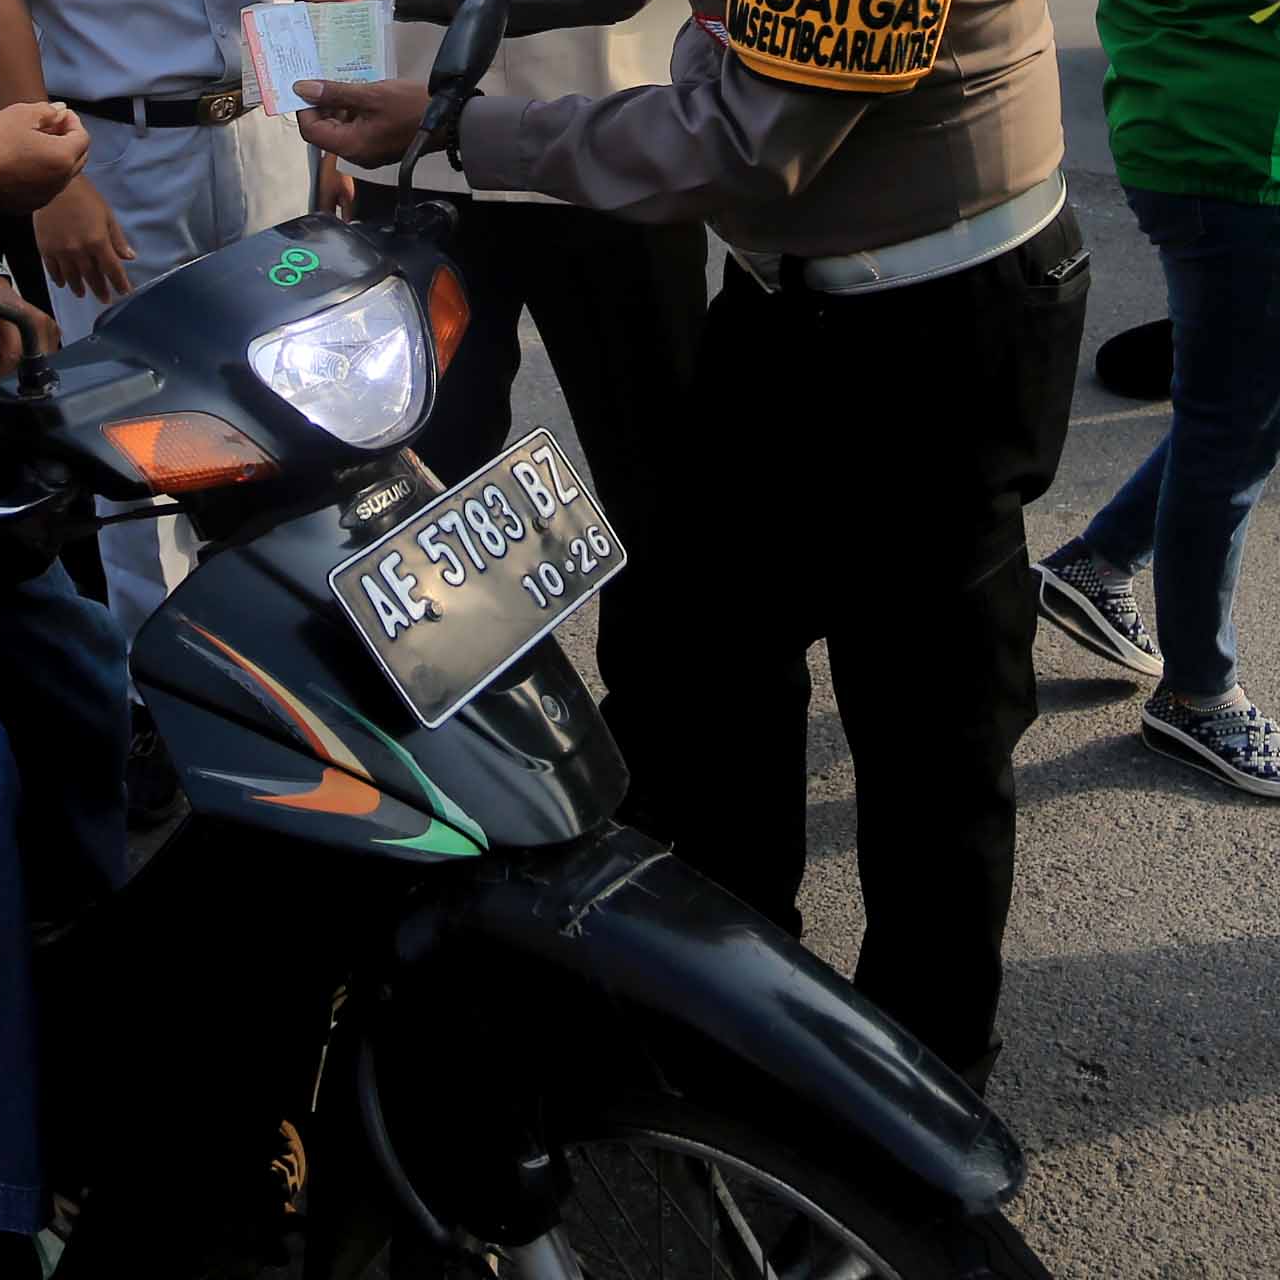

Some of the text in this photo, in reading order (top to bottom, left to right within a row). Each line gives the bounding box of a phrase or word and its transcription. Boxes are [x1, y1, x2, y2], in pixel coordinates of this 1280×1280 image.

[355, 479, 412, 522] SUZUKI
[360, 445, 580, 641] AE 5783 BZ
